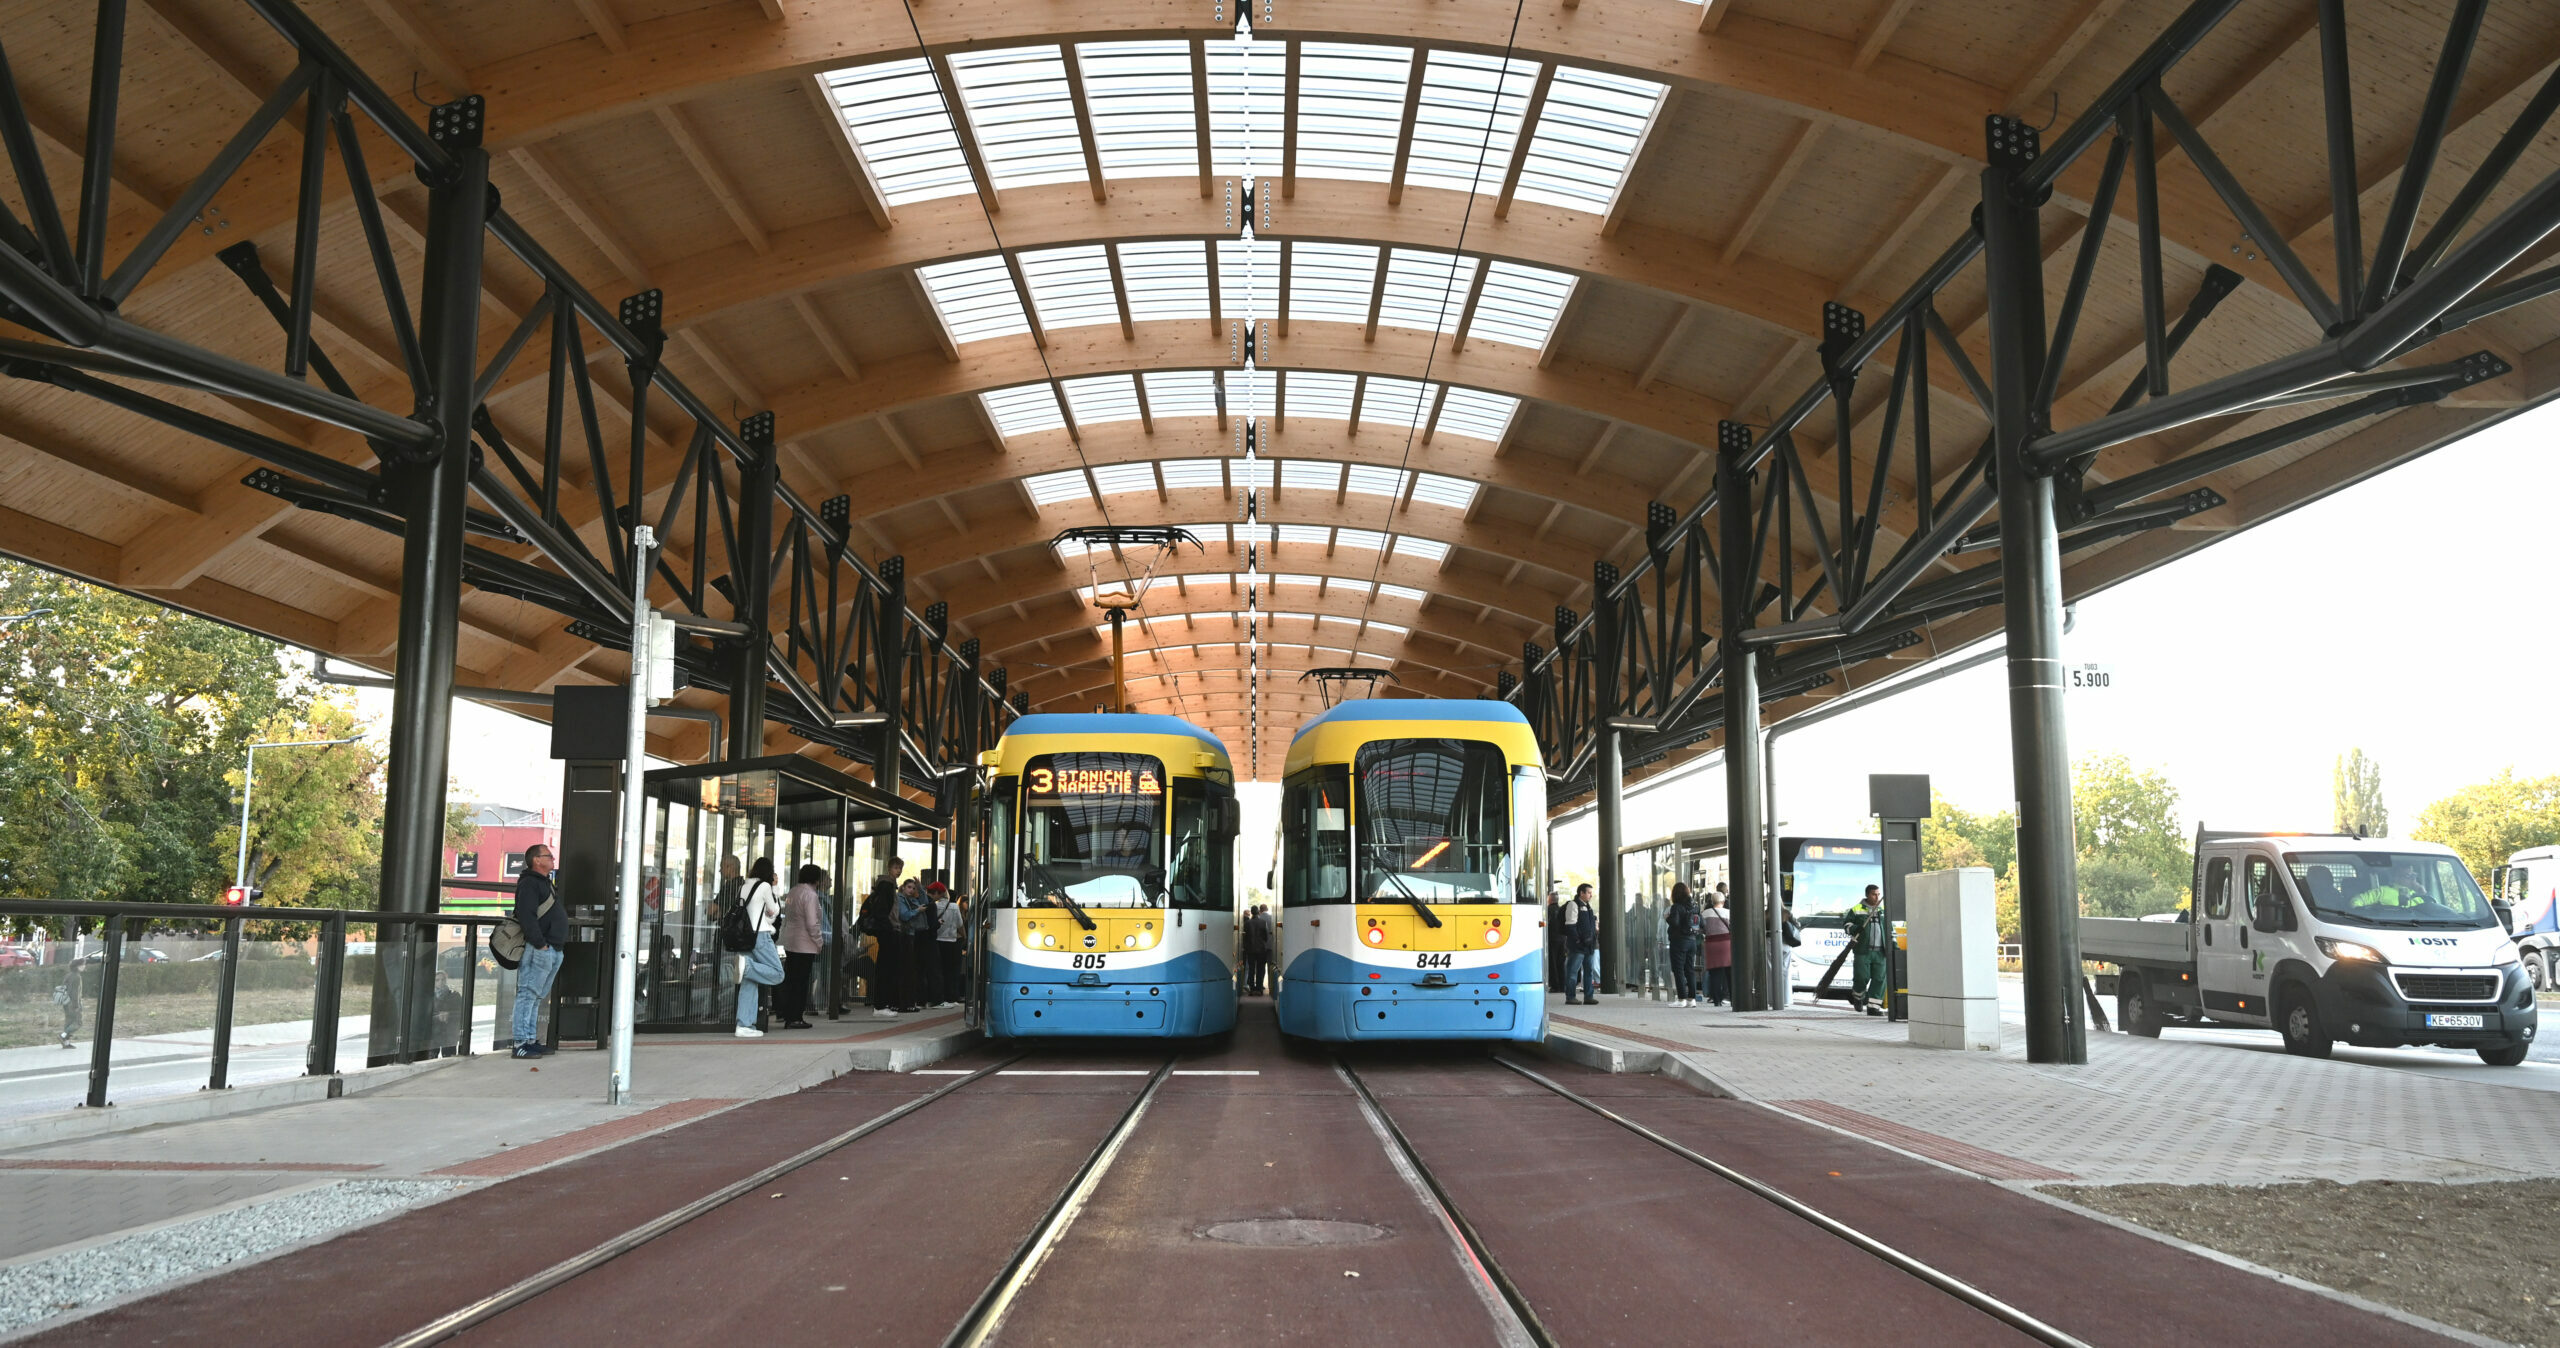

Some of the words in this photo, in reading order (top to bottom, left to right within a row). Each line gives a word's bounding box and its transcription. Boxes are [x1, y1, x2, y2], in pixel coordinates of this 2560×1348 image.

[2073, 670, 2110, 687] 5.900
[1031, 769, 1053, 793] 3
[2408, 938, 2458, 946] KOSIT
[1072, 953, 1106, 969] 805
[1416, 953, 1452, 968] 844
